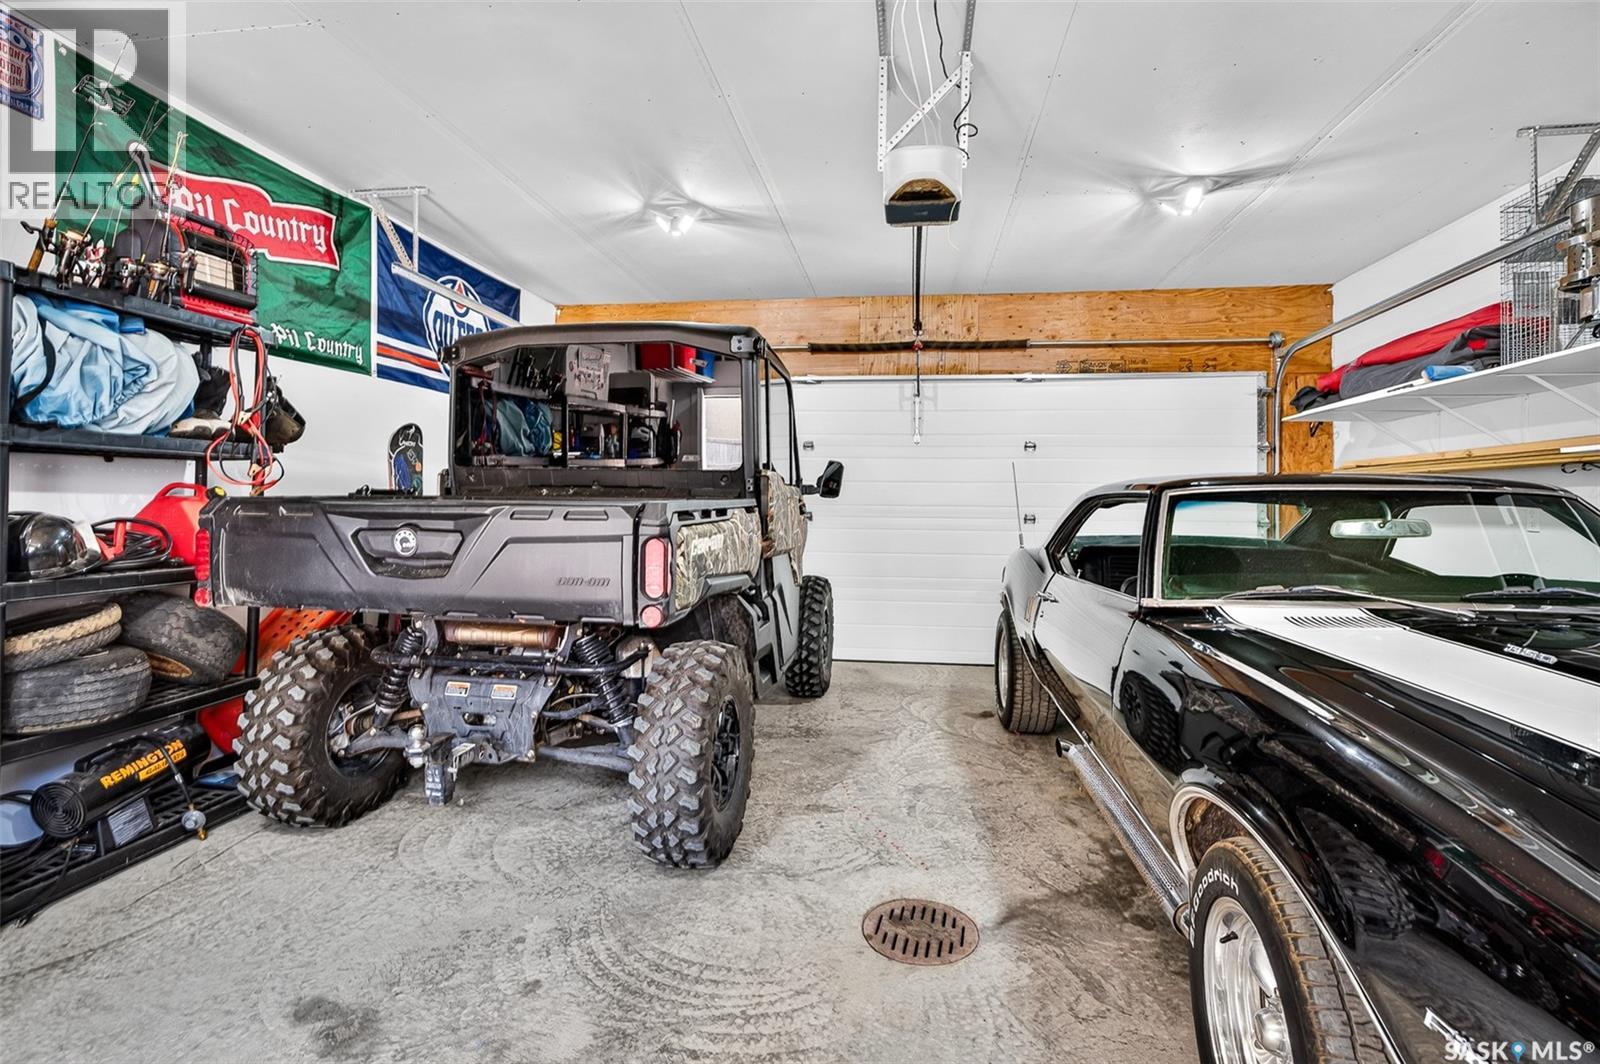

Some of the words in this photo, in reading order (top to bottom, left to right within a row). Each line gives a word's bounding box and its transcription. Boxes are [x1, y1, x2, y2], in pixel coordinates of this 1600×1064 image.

[222, 197, 328, 255] Country
[270, 322, 301, 349] Pil
[304, 330, 364, 366] Country
[432, 309, 484, 348] OIL
